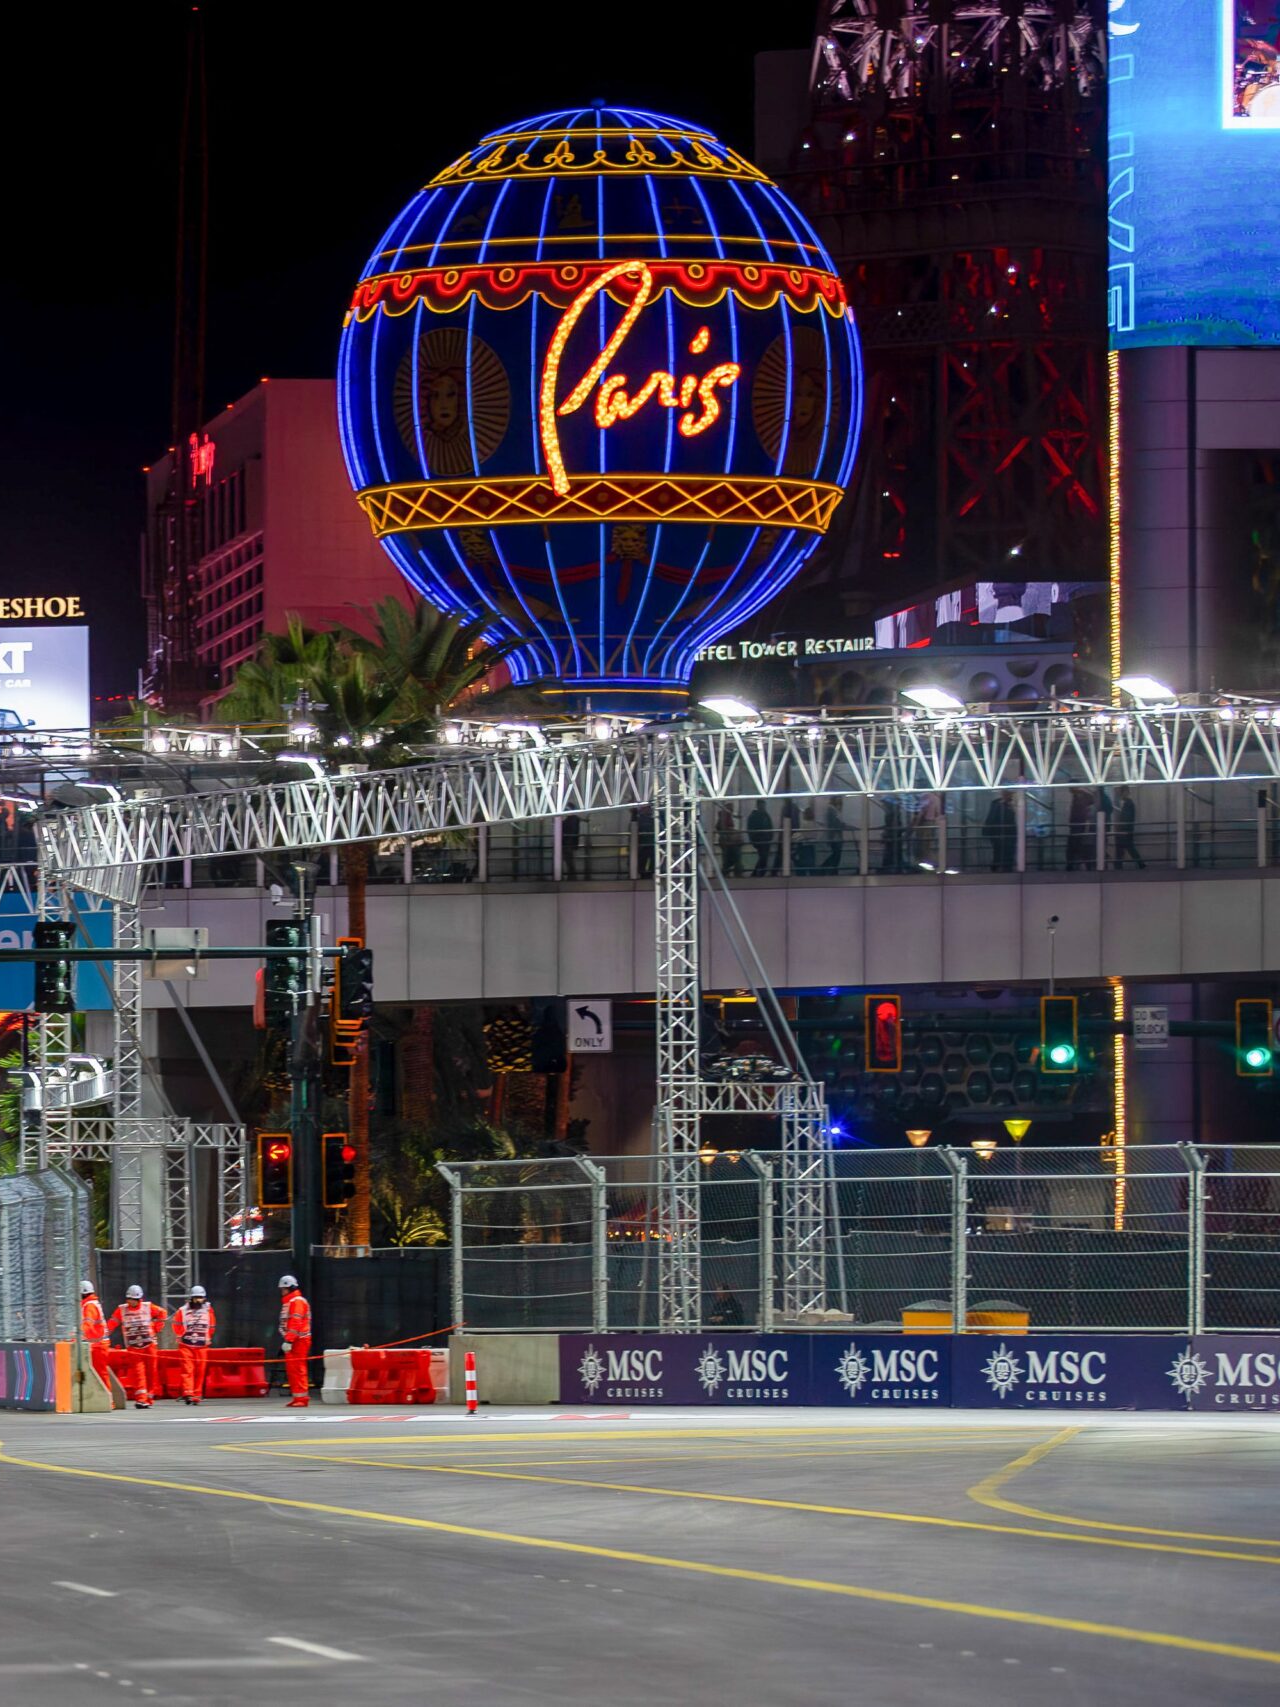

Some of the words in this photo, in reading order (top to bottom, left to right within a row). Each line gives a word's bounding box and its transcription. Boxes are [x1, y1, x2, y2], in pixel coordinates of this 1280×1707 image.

[540, 261, 740, 495] Paris
[694, 645, 736, 661] IFFEL
[739, 641, 797, 658] TOWER
[5, 680, 31, 688] CAR
[576, 1038, 604, 1047] ONLY
[607, 1350, 663, 1382] MSC
[727, 1350, 788, 1382] MSC
[871, 1350, 939, 1382] MSC
[1025, 1351, 1107, 1384] MSC
[1215, 1353, 1280, 1387] MS
[607, 1388, 664, 1397] CRUISES
[727, 1388, 789, 1398] CRUISES
[871, 1389, 939, 1399] CRUISES
[1025, 1391, 1107, 1401] CRUISES
